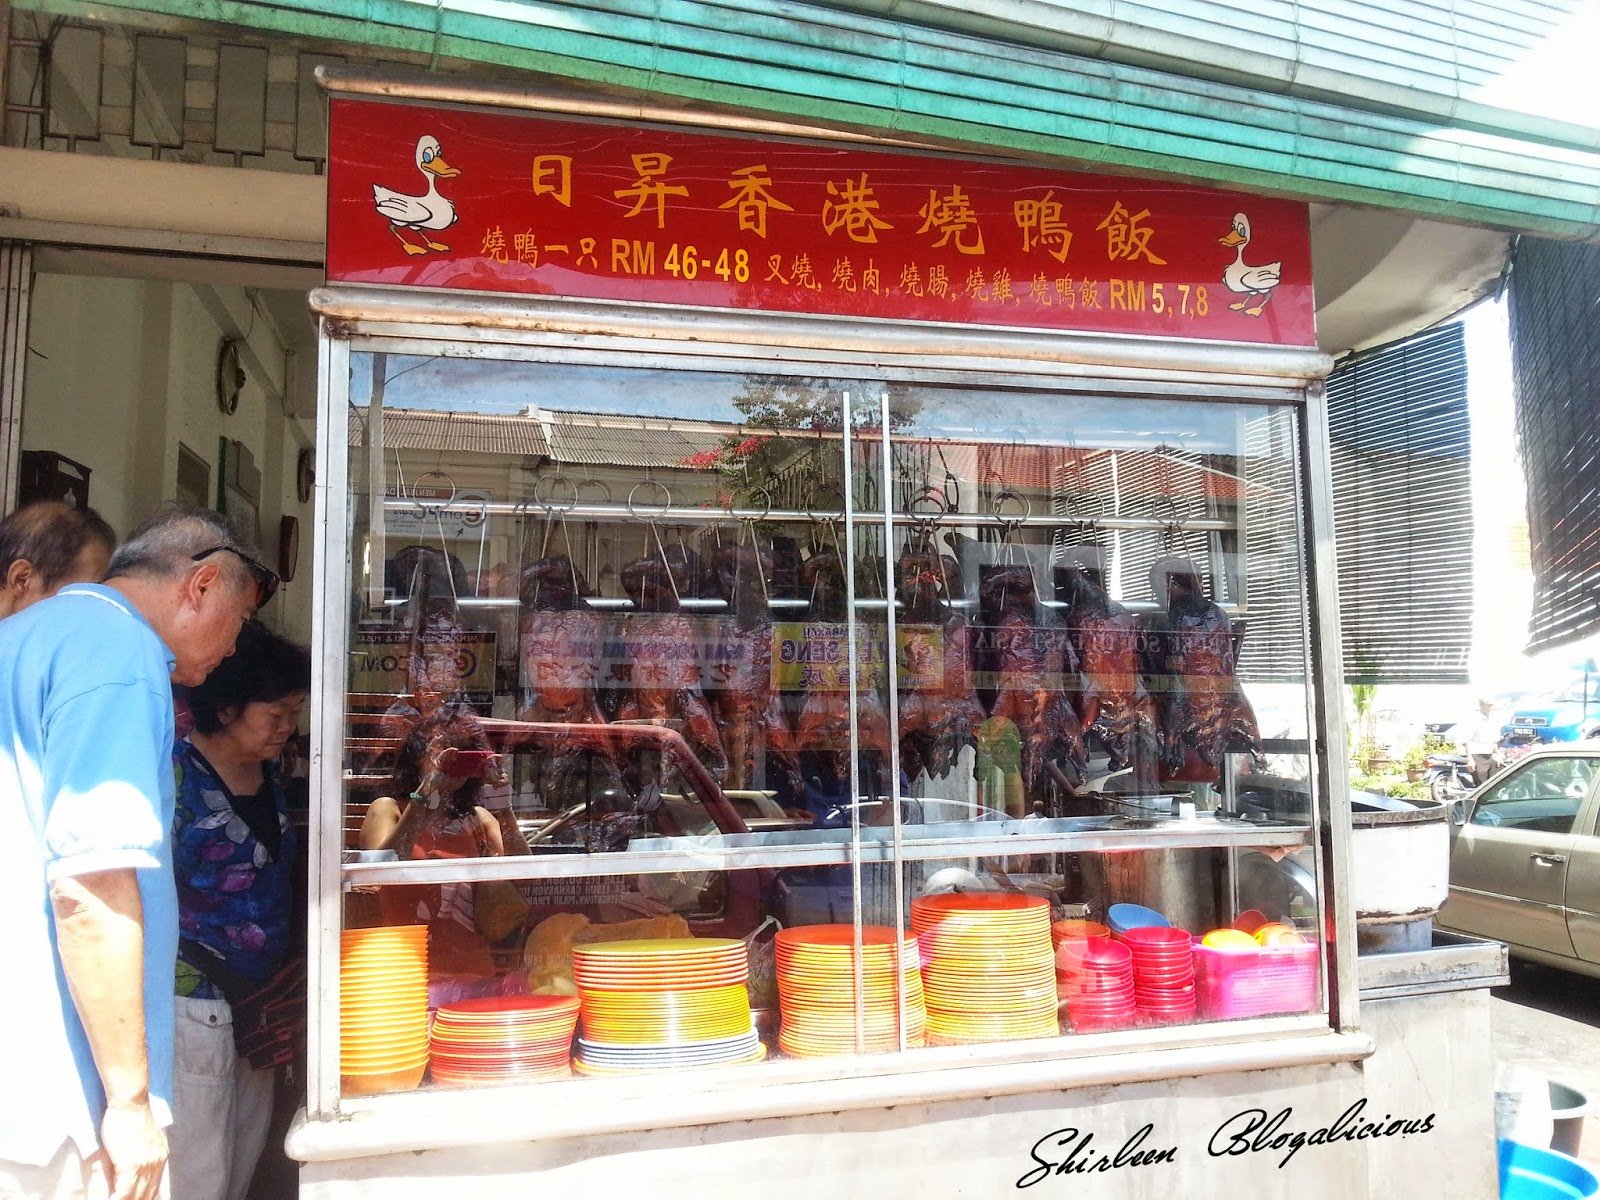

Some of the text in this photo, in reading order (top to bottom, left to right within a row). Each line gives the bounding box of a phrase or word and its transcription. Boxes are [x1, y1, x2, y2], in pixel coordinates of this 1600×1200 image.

[532, 152, 1168, 266] 日昇香港燒鴨飯
[480, 226, 599, 269] 燒鴨一只
[611, 239, 656, 275] RM
[664, 243, 750, 283] 46-48
[1109, 282, 1147, 313] RM
